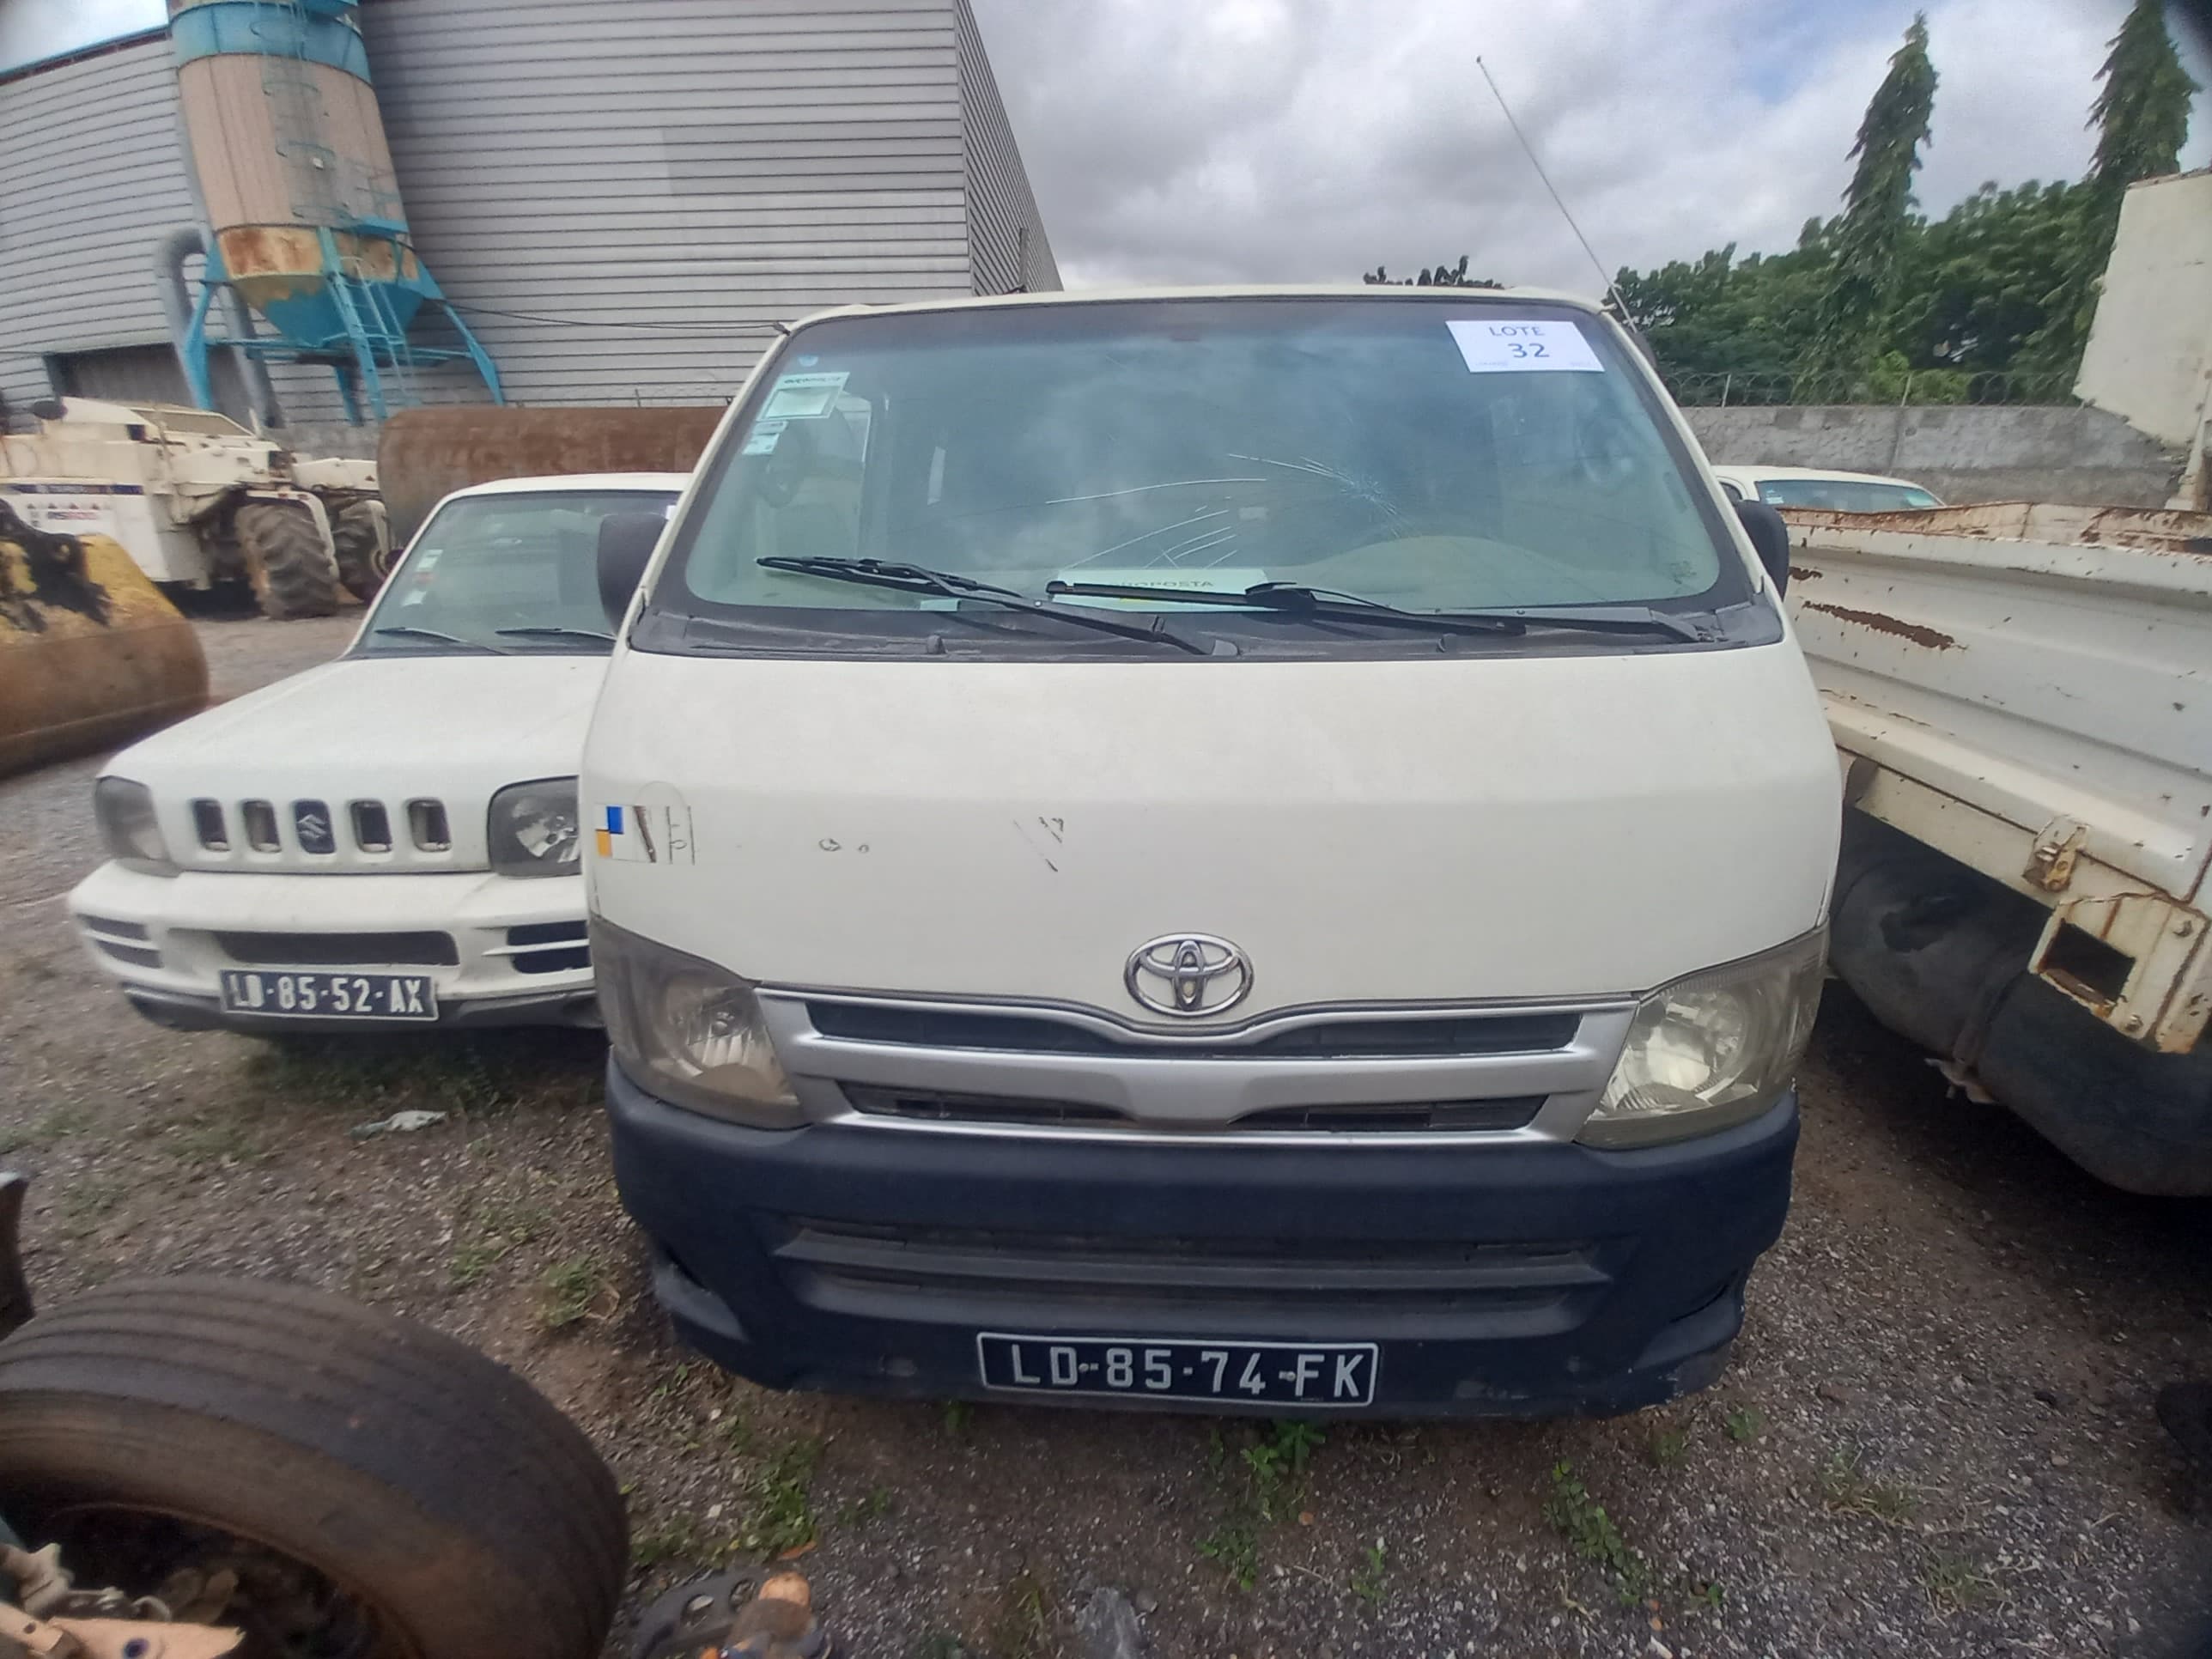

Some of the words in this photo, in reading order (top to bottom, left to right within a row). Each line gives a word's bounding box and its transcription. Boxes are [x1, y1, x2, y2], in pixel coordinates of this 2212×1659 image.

[1489, 326, 1545, 337] LOTE
[1508, 343, 1550, 358] 32
[1012, 1344, 1364, 1397] LD-85-74-FK
